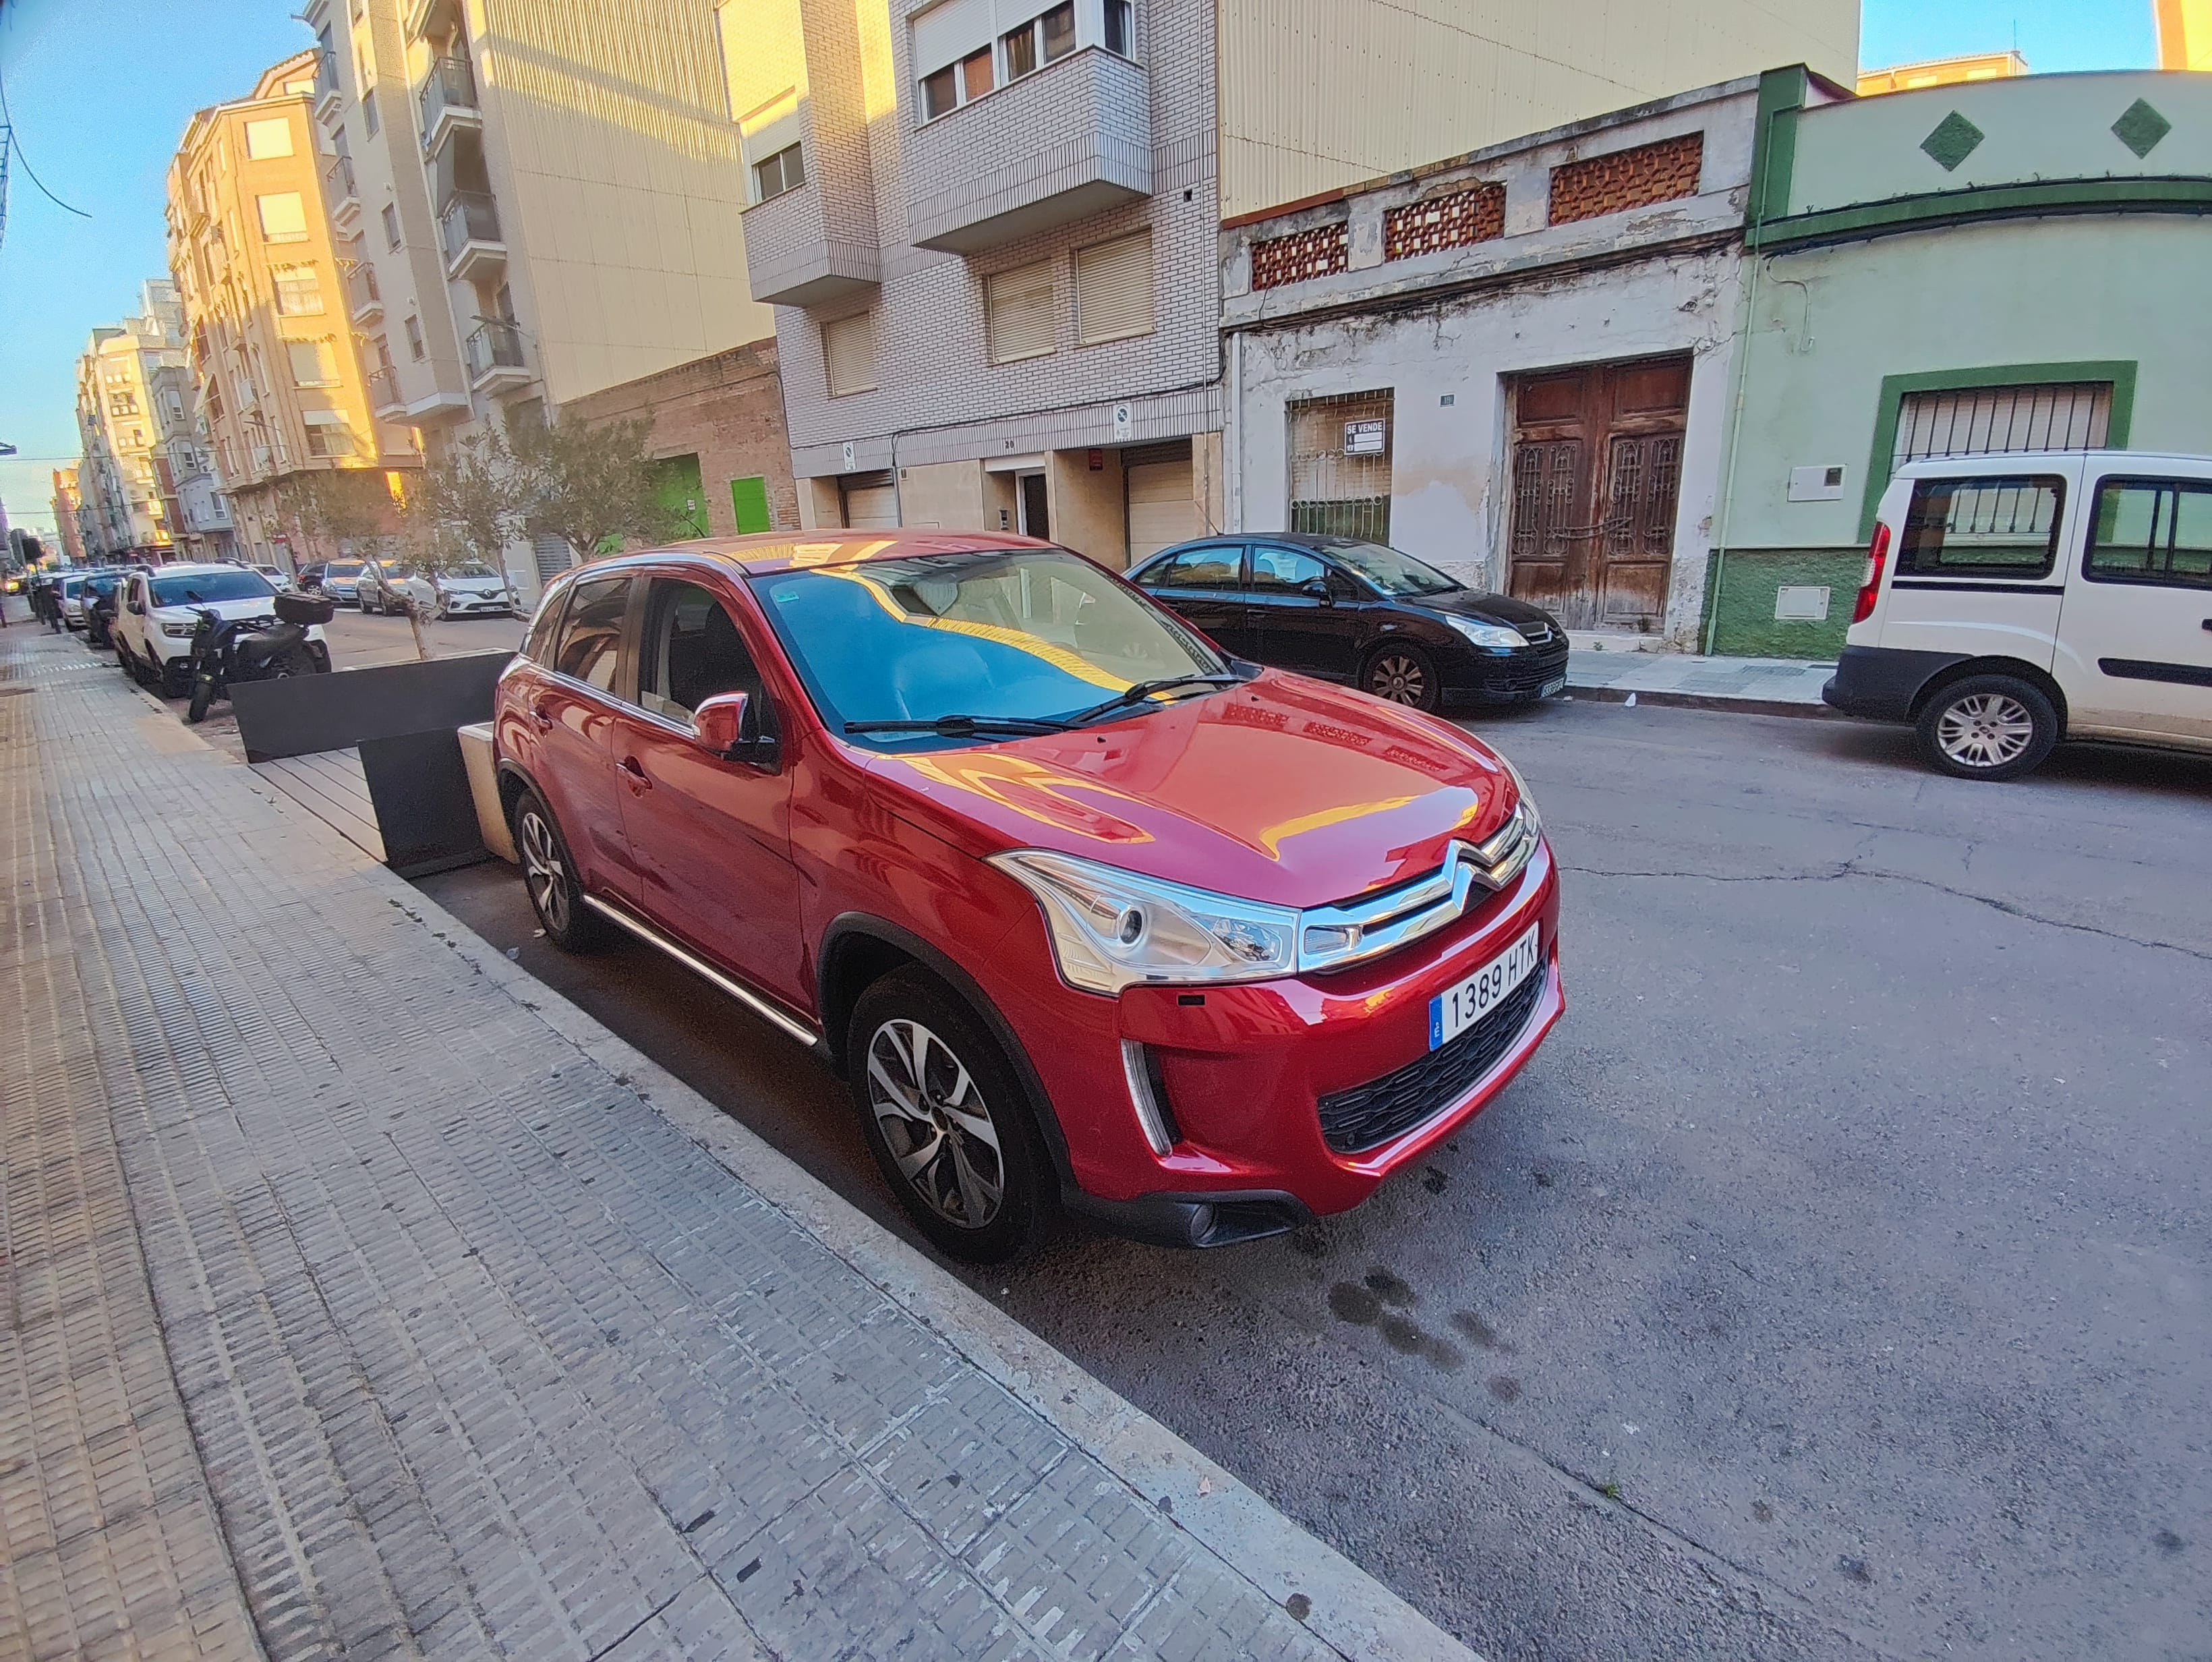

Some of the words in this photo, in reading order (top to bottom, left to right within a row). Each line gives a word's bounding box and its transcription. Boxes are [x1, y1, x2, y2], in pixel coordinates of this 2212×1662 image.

[1347, 424, 1357, 434] SE
[1358, 422, 1382, 432] VENDE
[1005, 440, 1014, 449] 20
[1452, 964, 1502, 1028] 1389
[1508, 929, 1536, 986] HTK
